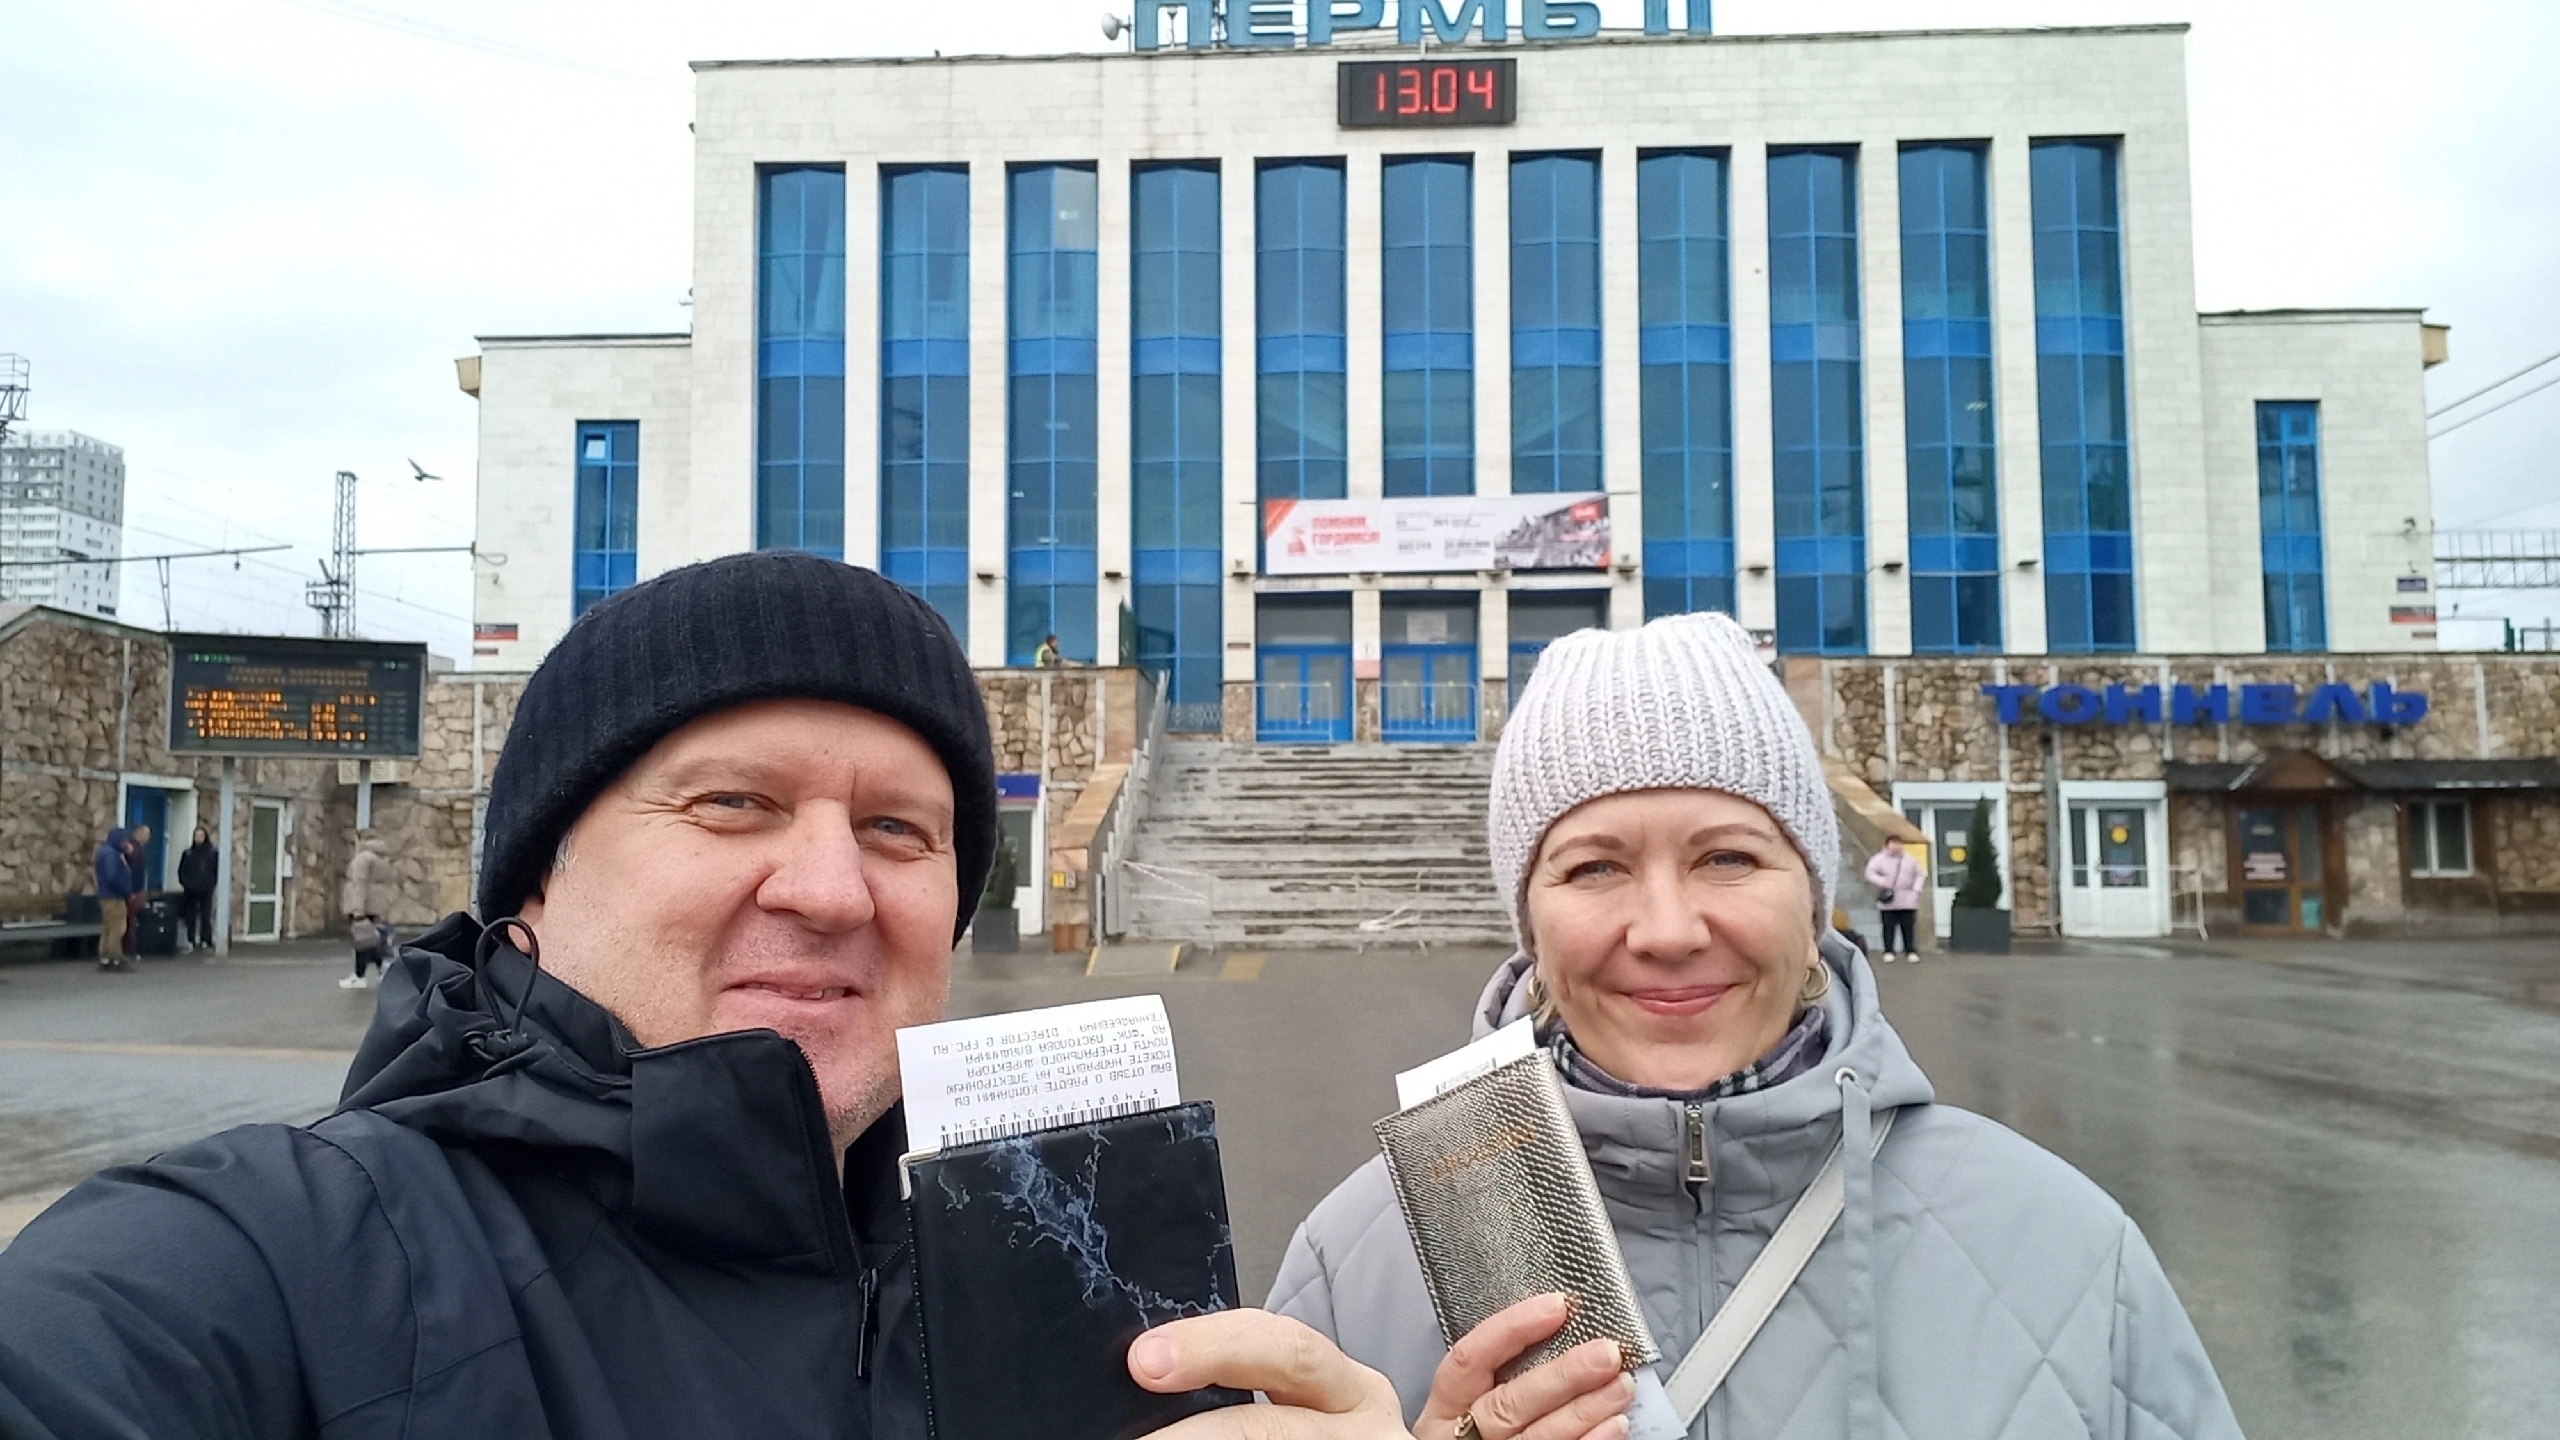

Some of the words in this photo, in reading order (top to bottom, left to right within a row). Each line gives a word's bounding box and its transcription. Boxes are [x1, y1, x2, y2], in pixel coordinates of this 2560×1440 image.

[1135, 0, 1600, 49] ПЕРМЬ
[1981, 683, 2429, 724] ТОННЕЛЬ
[1078, 1011, 1162, 1033] ГЕННАДЬЕВИЧА
[1151, 1023, 1165, 1035] АО
[999, 1026, 1058, 1045] DIRECTOR
[1038, 1033, 1104, 1052] ПЯСТОЛОВА
[1133, 1036, 1168, 1050] ПОЧТУ
[964, 1044, 1032, 1064] ВЛАДИМИРА
[1040, 1042, 1127, 1065] ГЕНЕРАЛЬНОГО
[1128, 1049, 1170, 1064] МОЖЕТЕ
[966, 1057, 1034, 1078] ДИРЕКТОРА
[1035, 1069, 1050, 1080] НА
[1056, 1057, 1122, 1076] НАПРАВИТЬ
[1108, 1066, 1144, 1081] ОТЗЫВ
[1150, 1062, 1171, 1074] ВАШ
[945, 1072, 1028, 1095] ЭЛЕКТРОННУЮ
[1044, 1075, 1088, 1091] РАБОТЕ
[953, 1095, 970, 1107] ВЫ
[976, 1084, 1038, 1103] КОМПАНИИ
